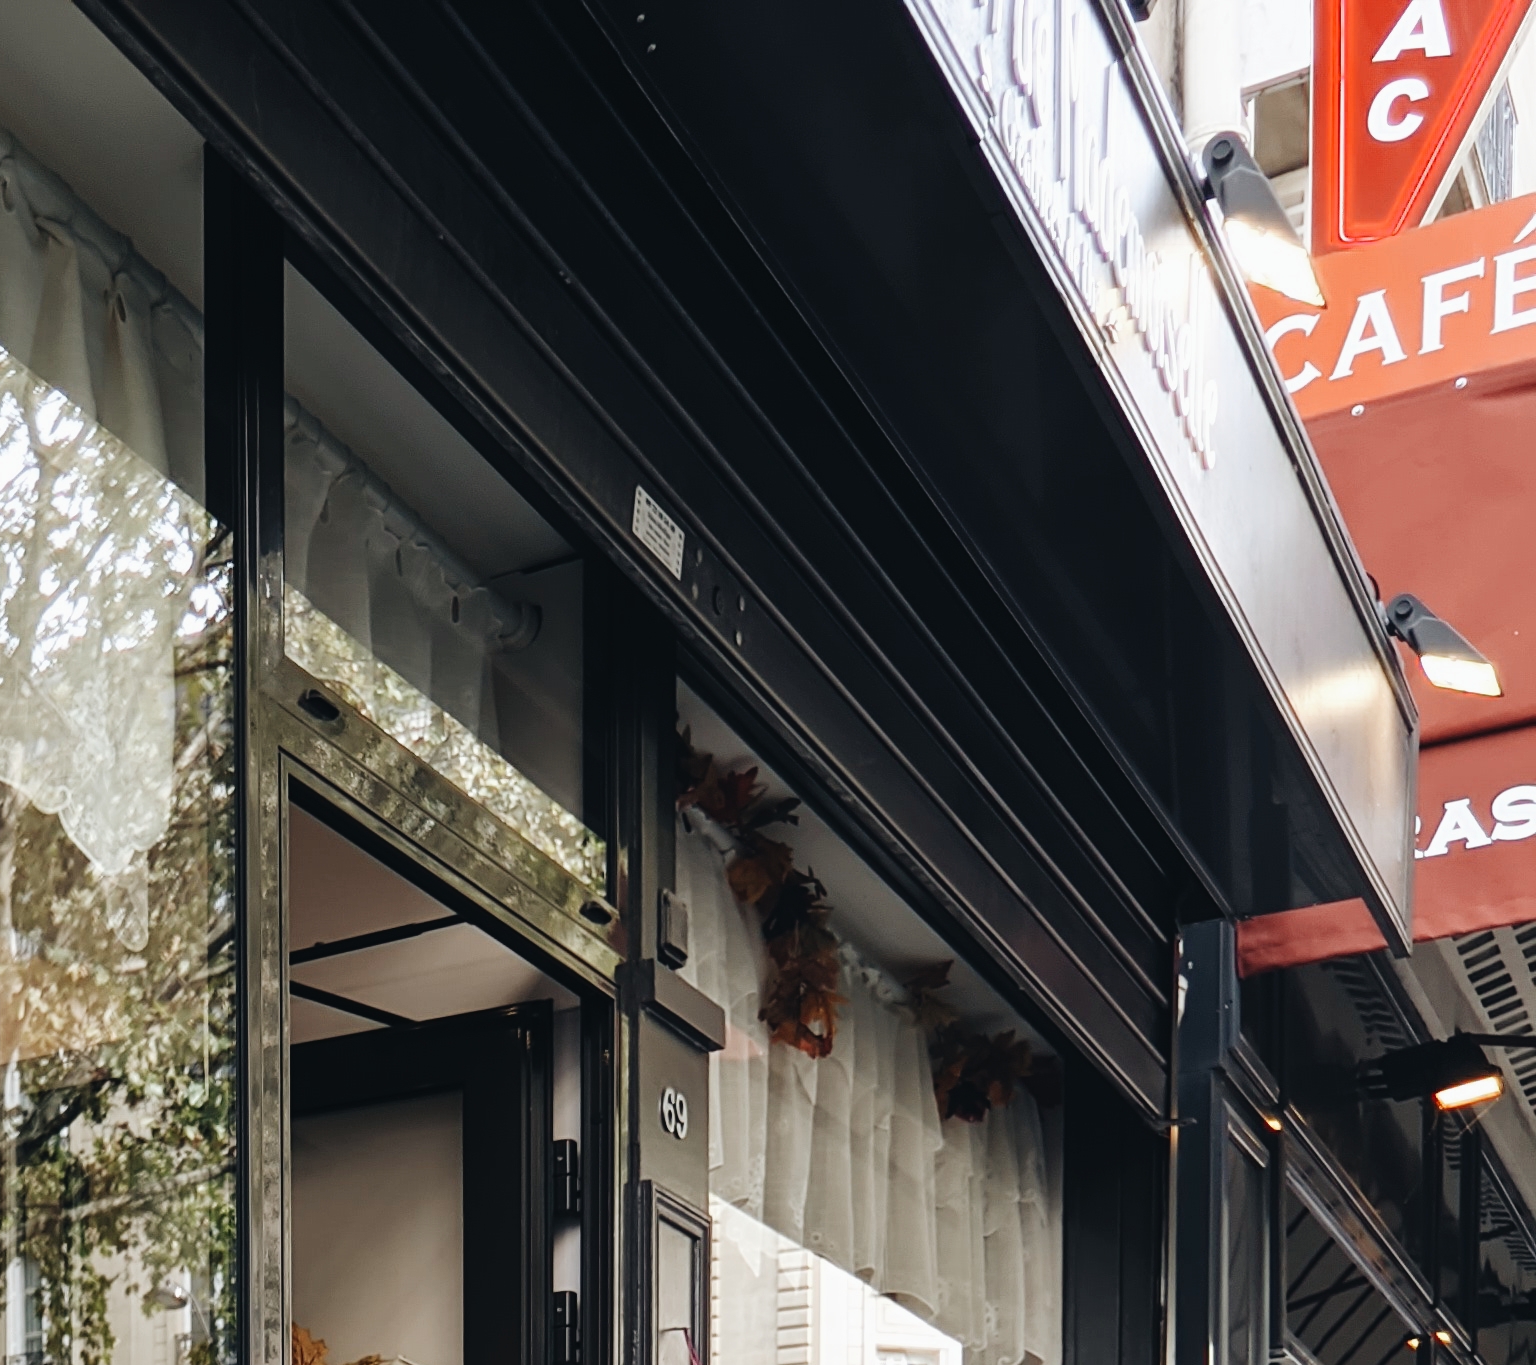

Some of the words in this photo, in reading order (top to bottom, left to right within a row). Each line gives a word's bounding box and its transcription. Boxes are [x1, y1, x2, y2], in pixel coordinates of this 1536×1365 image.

[1264, 212, 1536, 393] CAFÉ
[1413, 785, 1536, 858] AS
[662, 1087, 688, 1139] 69
